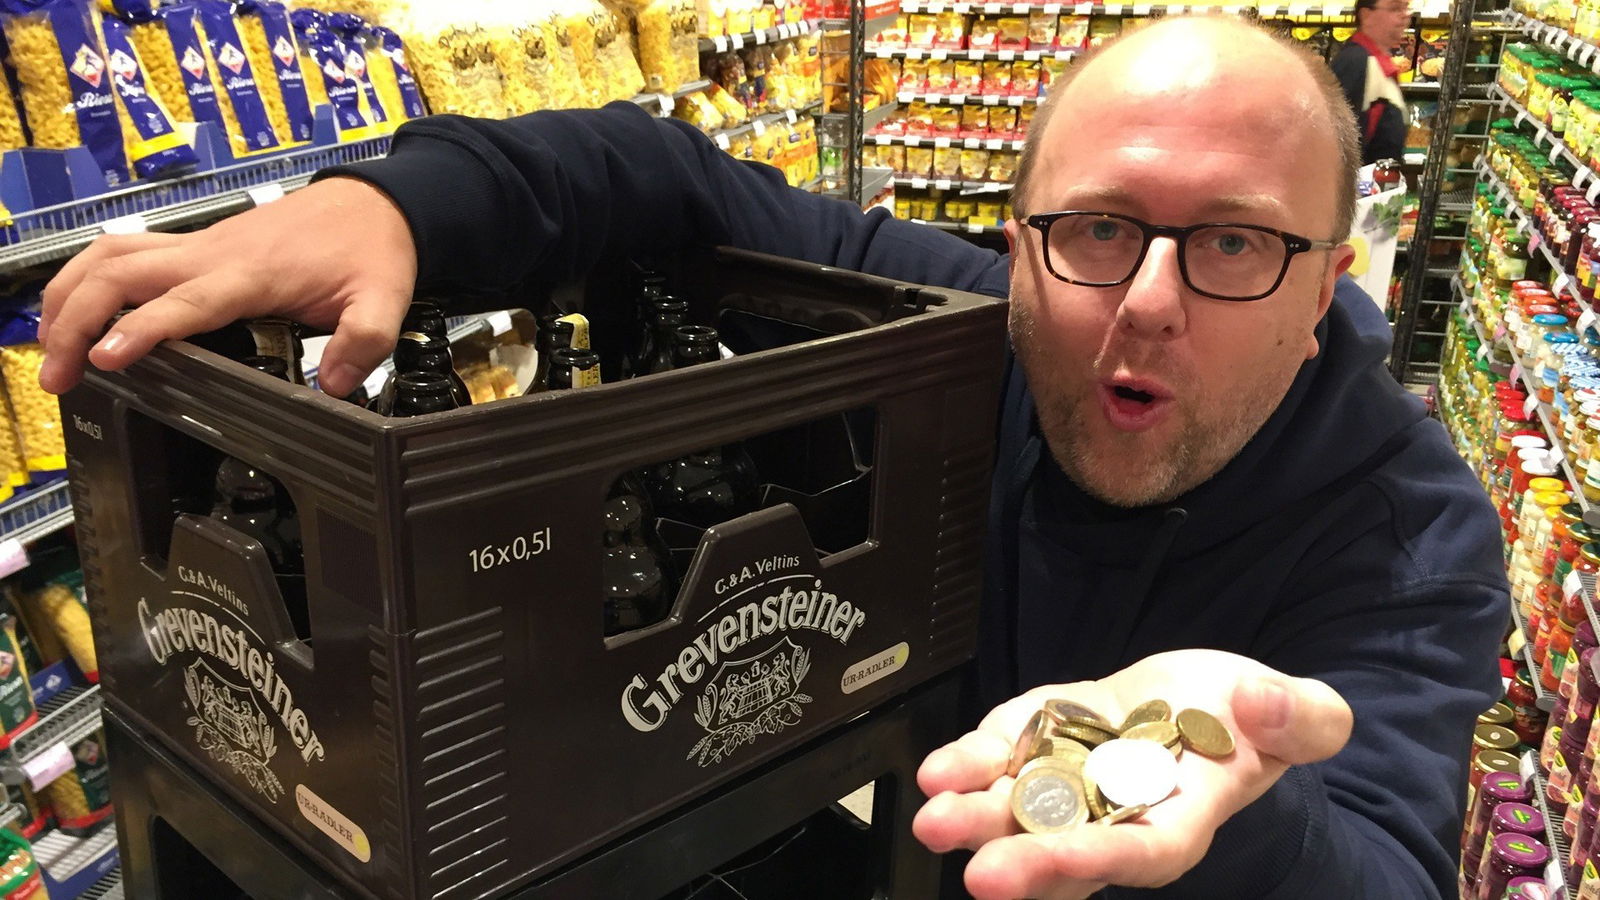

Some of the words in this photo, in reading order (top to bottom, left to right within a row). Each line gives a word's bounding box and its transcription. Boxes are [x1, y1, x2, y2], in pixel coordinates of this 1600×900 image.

[138, 597, 325, 766] Grevensteiner
[621, 579, 866, 733] Grevensteiner
[843, 655, 895, 687] UR-RADLER
